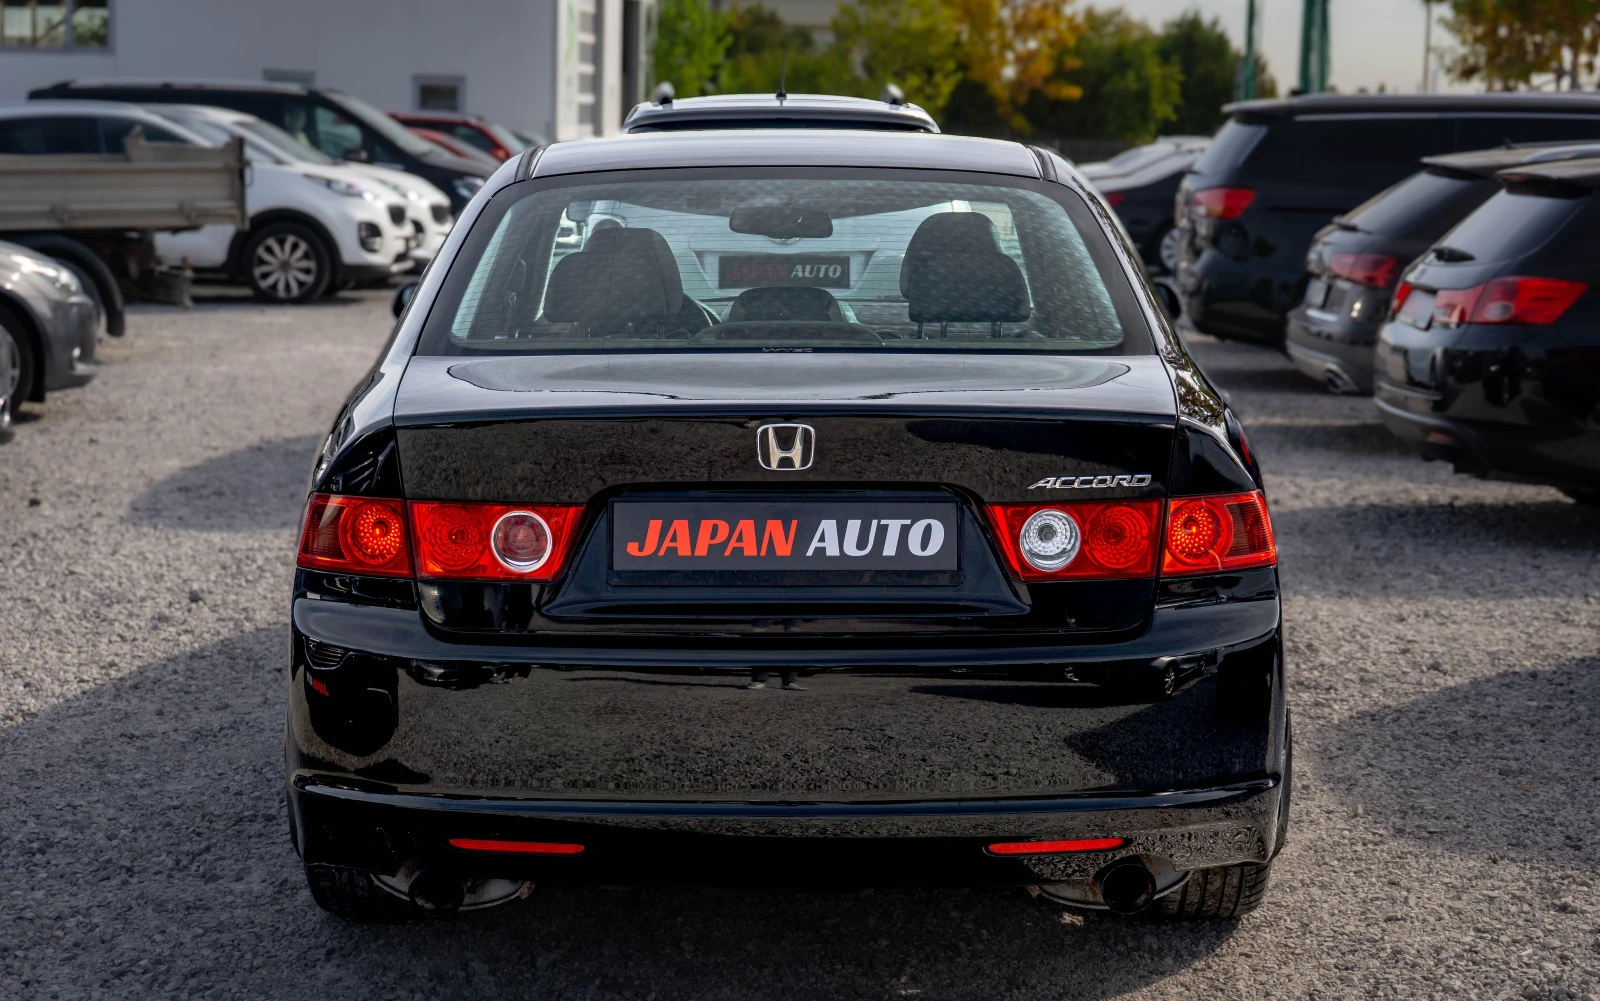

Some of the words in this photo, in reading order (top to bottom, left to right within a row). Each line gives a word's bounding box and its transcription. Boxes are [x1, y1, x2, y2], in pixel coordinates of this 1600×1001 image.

[791, 264, 841, 278] AUTO
[1027, 474, 1152, 489] ACCORD
[626, 519, 798, 557] JAPAN
[806, 518, 945, 557] AUTO
